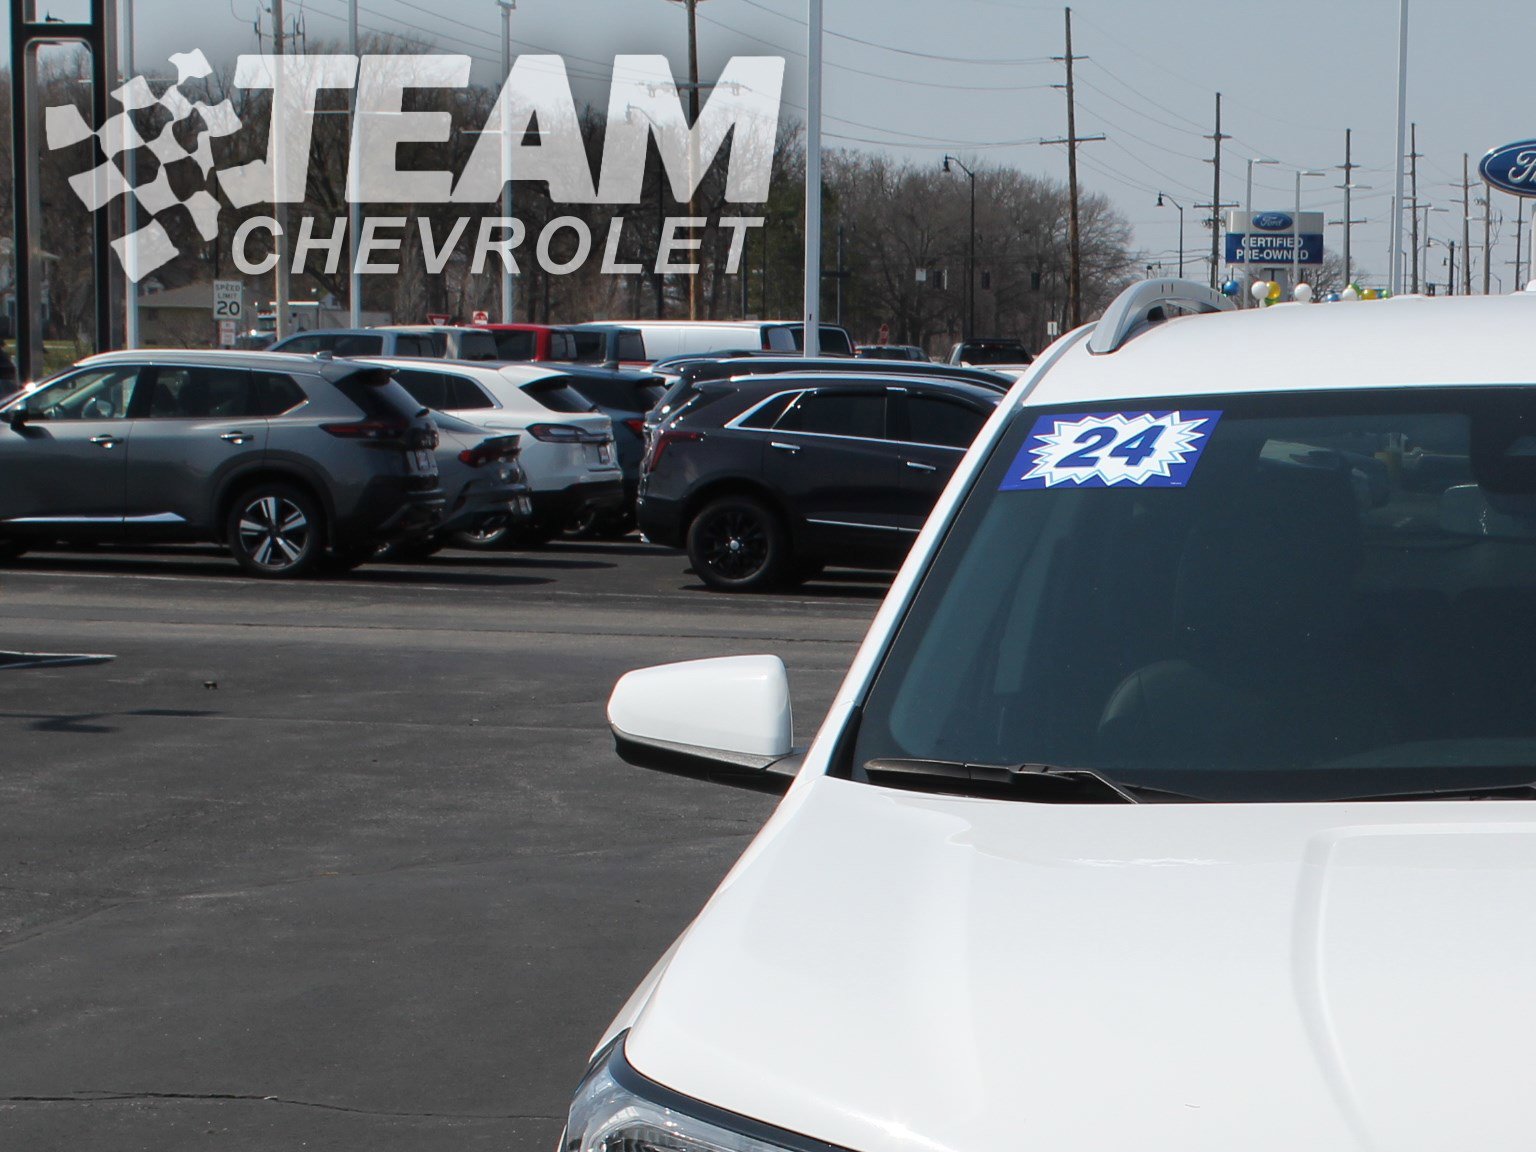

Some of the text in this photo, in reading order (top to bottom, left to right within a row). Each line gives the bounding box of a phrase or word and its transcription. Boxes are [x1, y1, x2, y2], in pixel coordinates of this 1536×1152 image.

[1260, 215, 1284, 227] Ford
[1236, 249, 1309, 260] PE-OWND
[217, 300, 240, 316] 20
[1054, 425, 1168, 468] 24
